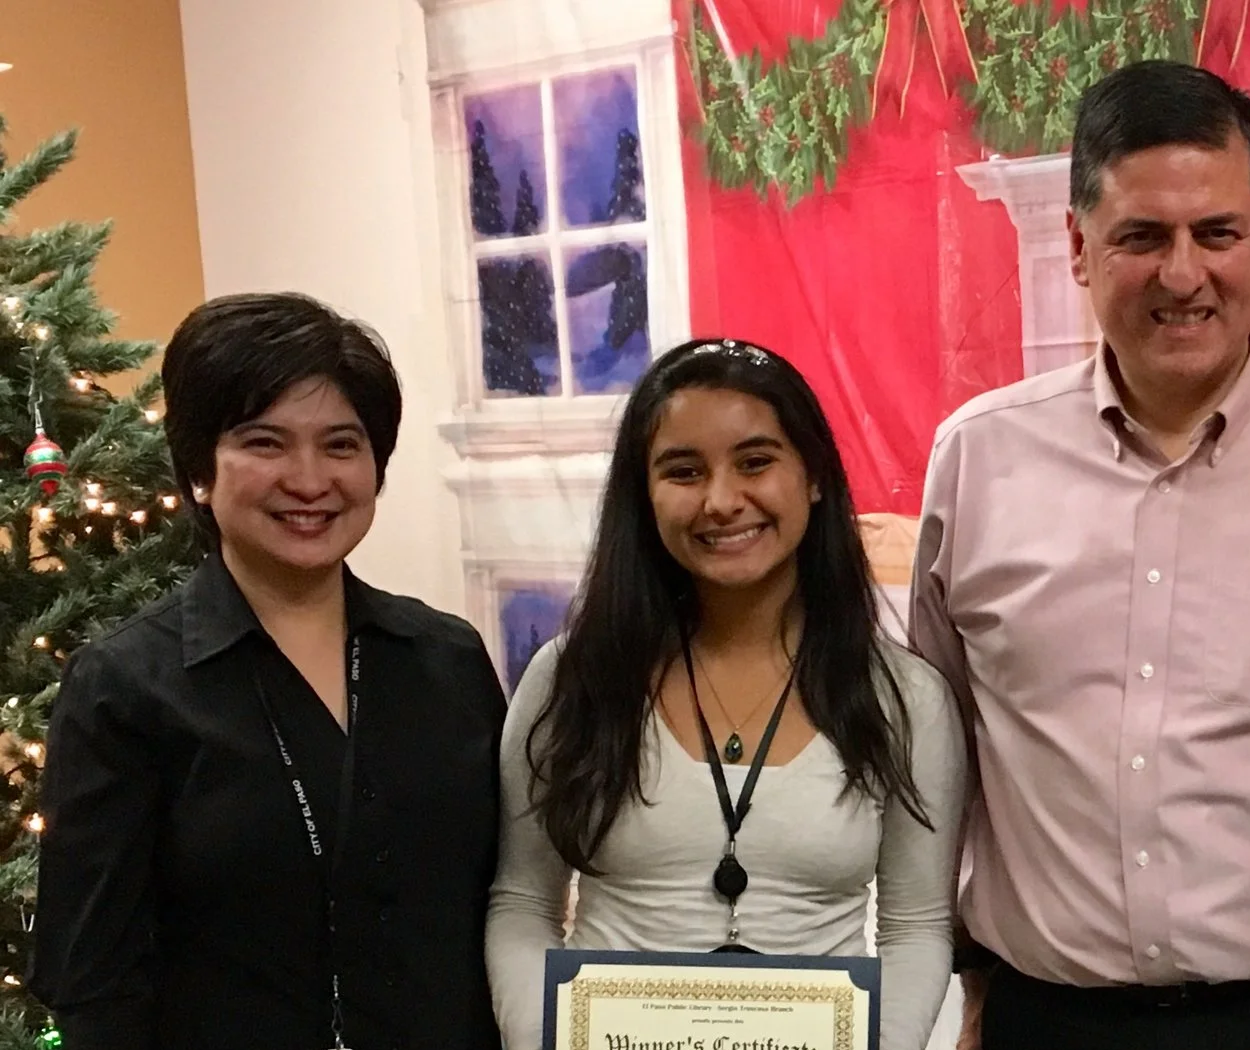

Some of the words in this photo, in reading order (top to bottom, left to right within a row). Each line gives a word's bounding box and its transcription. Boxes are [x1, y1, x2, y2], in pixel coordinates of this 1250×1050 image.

[292, 779, 307, 804] PASO
[302, 804, 312, 817] EL
[305, 818, 315, 832] OF
[309, 833, 321, 855] CITY
